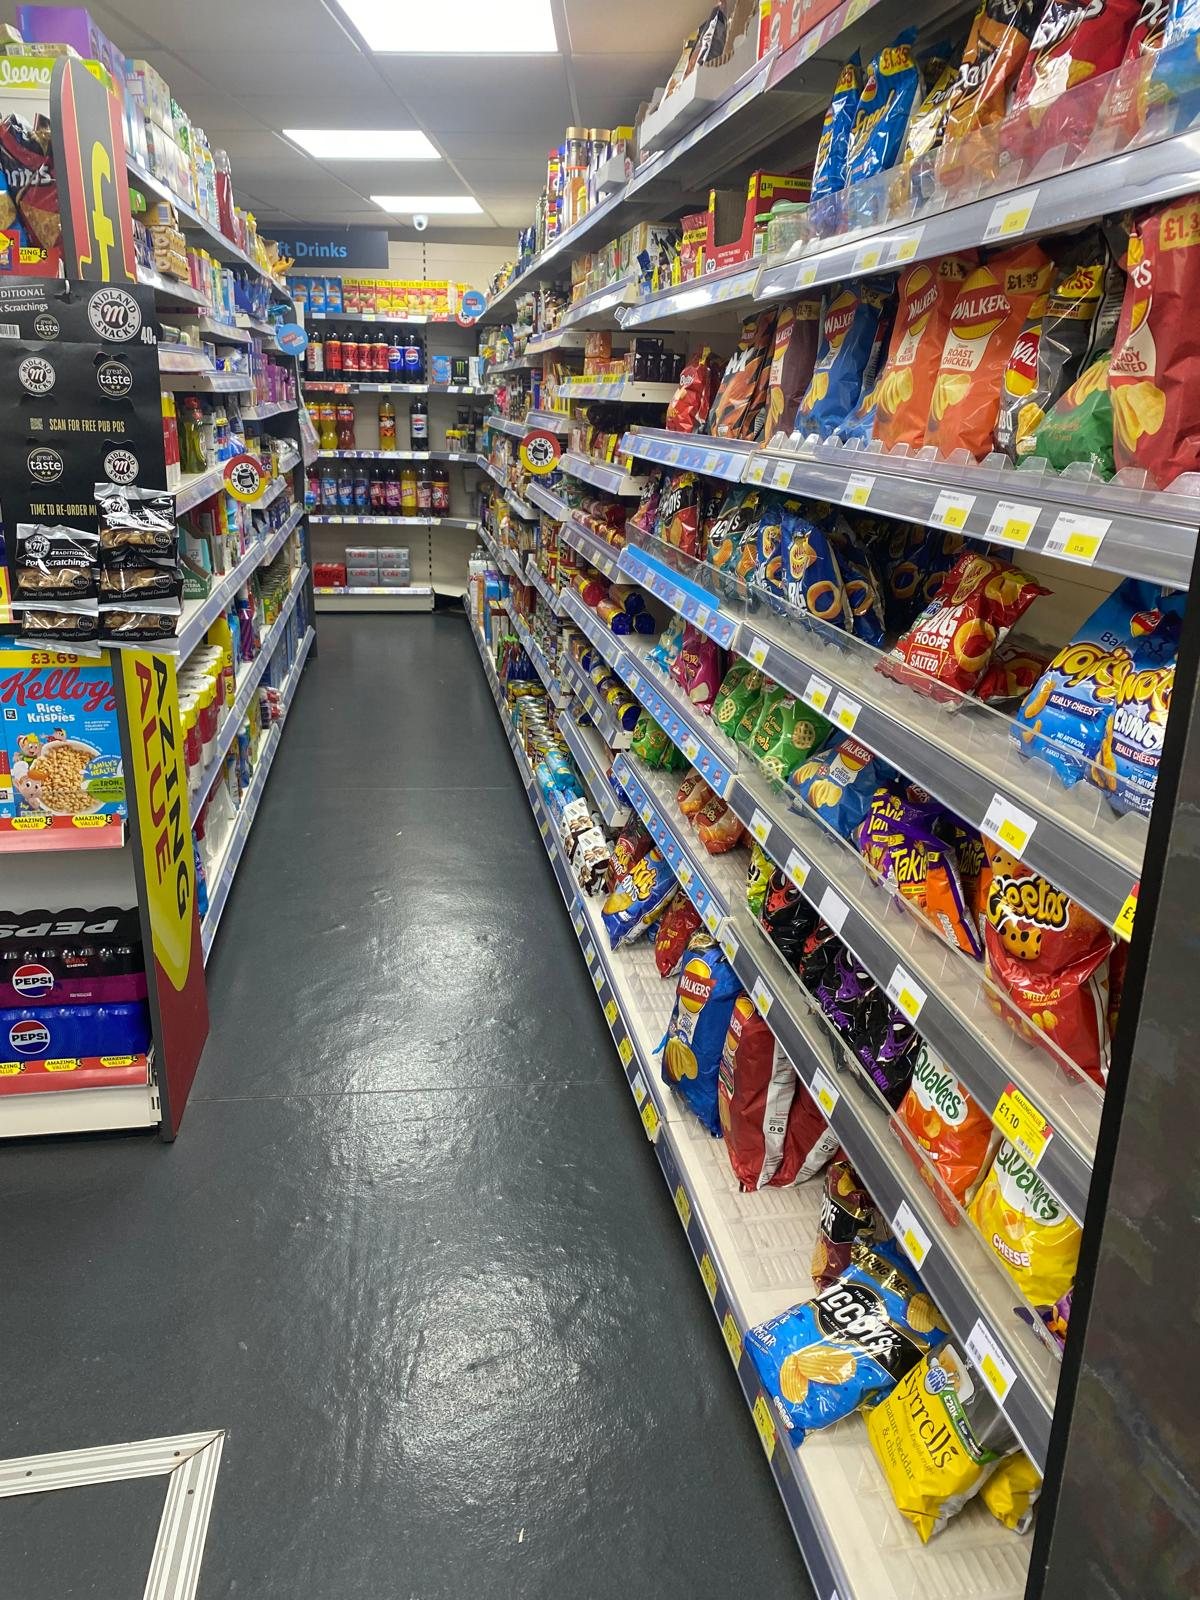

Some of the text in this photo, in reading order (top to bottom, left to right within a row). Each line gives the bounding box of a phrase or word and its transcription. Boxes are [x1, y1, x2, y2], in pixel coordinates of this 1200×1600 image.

[296, 242, 347, 257] Drinks
[4, 302, 48, 312] Scratchings
[92, 288, 136, 313] MIDLAND
[908, 284, 938, 320] WALKERS
[951, 294, 1010, 320] WALKERS
[36, 323, 58, 332] taste
[95, 321, 136, 340] SNACKS
[948, 349, 974, 358] ROAST
[942, 357, 974, 368] CHICKEN
[100, 374, 130, 385] taste
[49, 419, 125, 433] SCAN FOR FREE PUB POS
[30, 460, 61, 471] taste
[30, 504, 43, 516] TIME
[43, 504, 54, 515] TO
[56, 504, 87, 516] RE-ORDER
[45, 558, 90, 568] Scratchings
[915, 632, 949, 649] HOOPS
[30, 653, 78, 664] £3.69
[910, 654, 939, 672] SALTED
[36, 703, 62, 713] Rice
[1051, 695, 1099, 717] REALLY CHEESY
[27, 713, 75, 723] Krispies
[840, 740, 873, 762] WALKERS
[1115, 743, 1160, 767] REALLY CHEESY
[834, 768, 852, 780] CHEESE
[14, 817, 44, 825] AMAZING
[15, 977, 52, 985] PEPSI
[681, 975, 711, 998] WALKERS
[11, 1032, 48, 1041] PEPSI
[913, 1041, 962, 1120] Quavers
[998, 1102, 1020, 1129] £1.10
[992, 1233, 1030, 1267] CHEESE
[927, 1374, 942, 1392] WIN
[944, 1394, 958, 1419] £20K
[886, 1438, 897, 1468] chive
